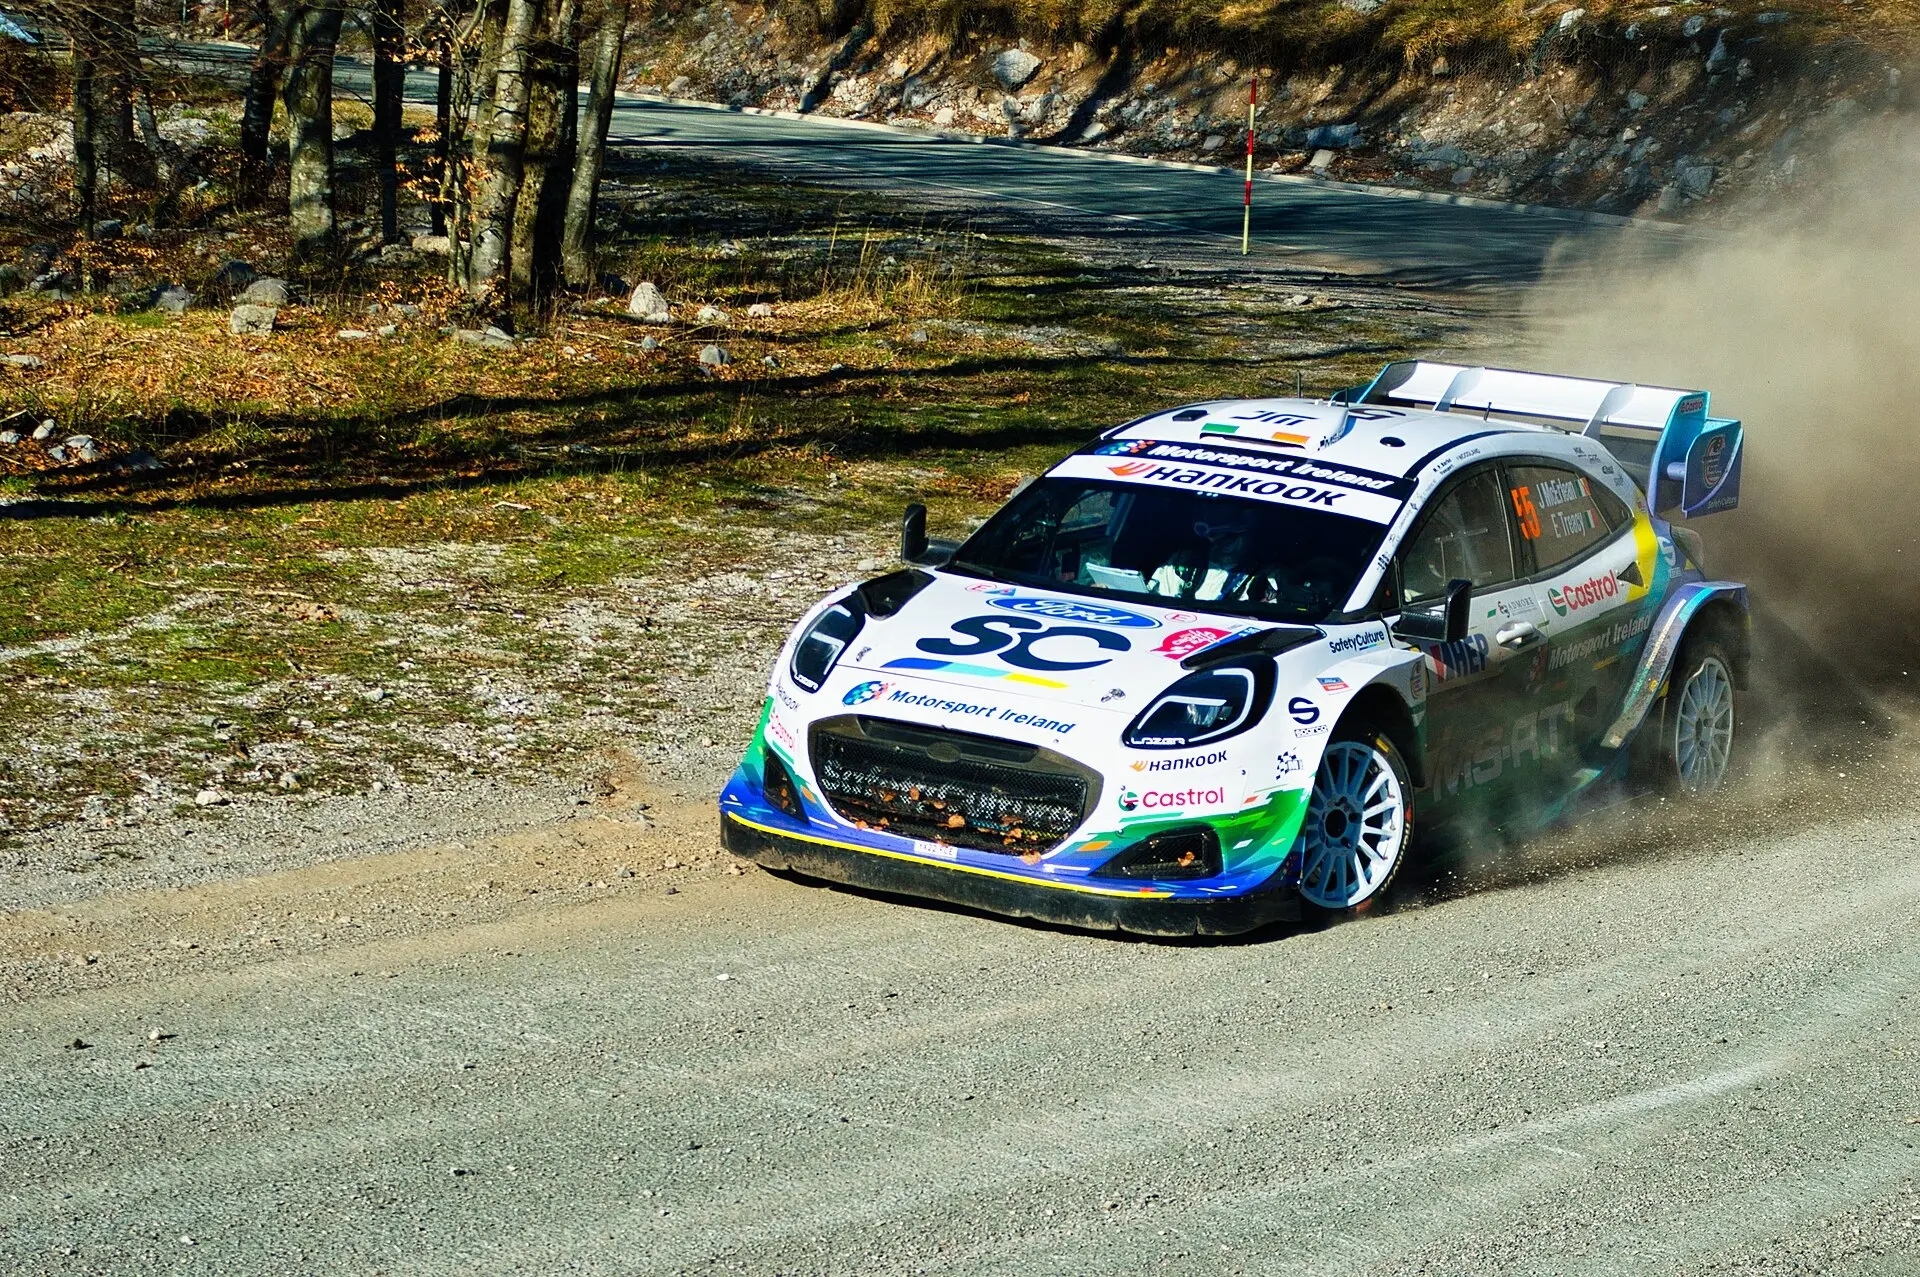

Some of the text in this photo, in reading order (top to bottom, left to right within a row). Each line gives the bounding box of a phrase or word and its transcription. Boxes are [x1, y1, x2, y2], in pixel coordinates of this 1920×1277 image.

[1147, 444, 1395, 490] Motorsport Ireland
[1563, 569, 1619, 610] Castrol
[1013, 599, 1132, 624] Ford
[1329, 630, 1385, 654] SafetyCulture
[887, 690, 1076, 733] Motorsport Ireland
[1142, 787, 1224, 808] Castrol
